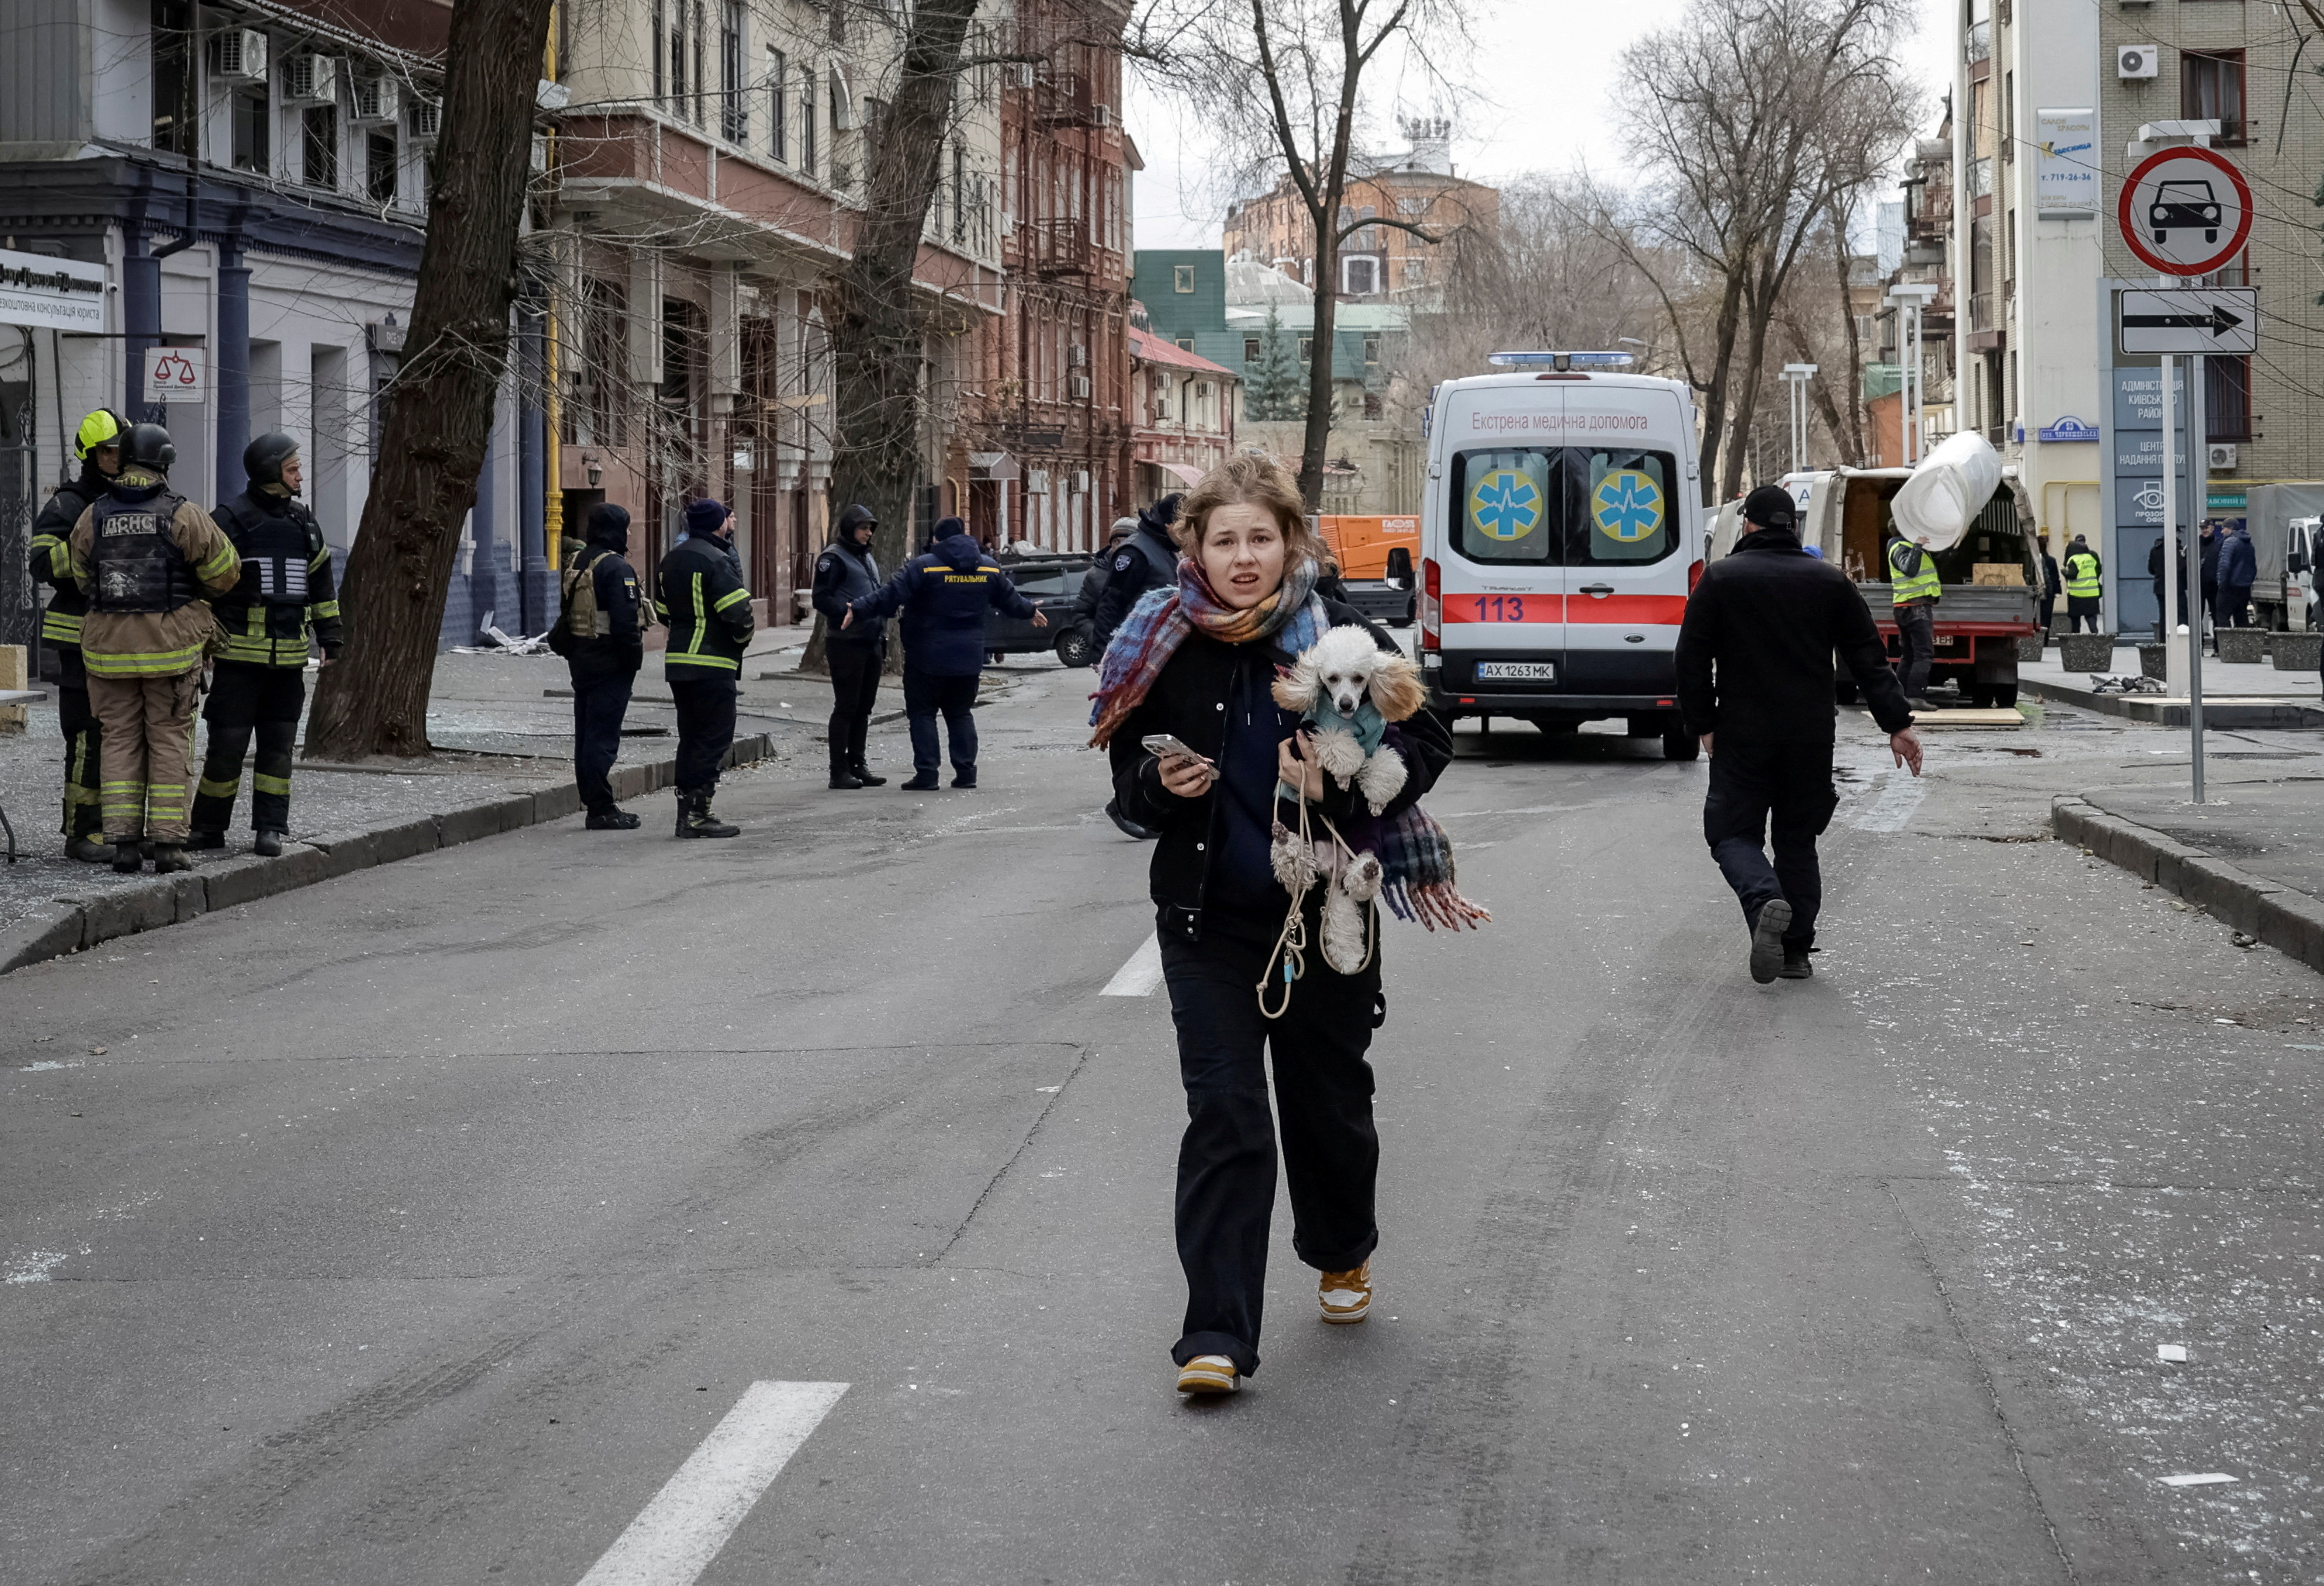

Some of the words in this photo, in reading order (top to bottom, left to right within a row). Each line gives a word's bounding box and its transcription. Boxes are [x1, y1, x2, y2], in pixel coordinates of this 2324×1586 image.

[0, 298, 36, 313] езкоштовна
[37, 302, 76, 319] консультація
[77, 307, 99, 321] юриста
[2122, 380, 2183, 391] АДМІНІСТРІЯ
[2129, 394, 2177, 405] КИЇВСЬКО
[2138, 407, 2163, 419] РАЙОН
[1472, 412, 1528, 433] Екстрена
[1533, 415, 1585, 431] медична
[1589, 416, 1647, 431] допомога
[2140, 442, 2164, 452] ЦЕНТР
[2119, 454, 2157, 466] НАДАННЯ
[105, 516, 153, 534] ДСНС
[1475, 597, 1523, 621] 113
[1486, 665, 1502, 676] AX
[1505, 665, 1530, 676] 1263
[1533, 666, 1550, 677] MK
